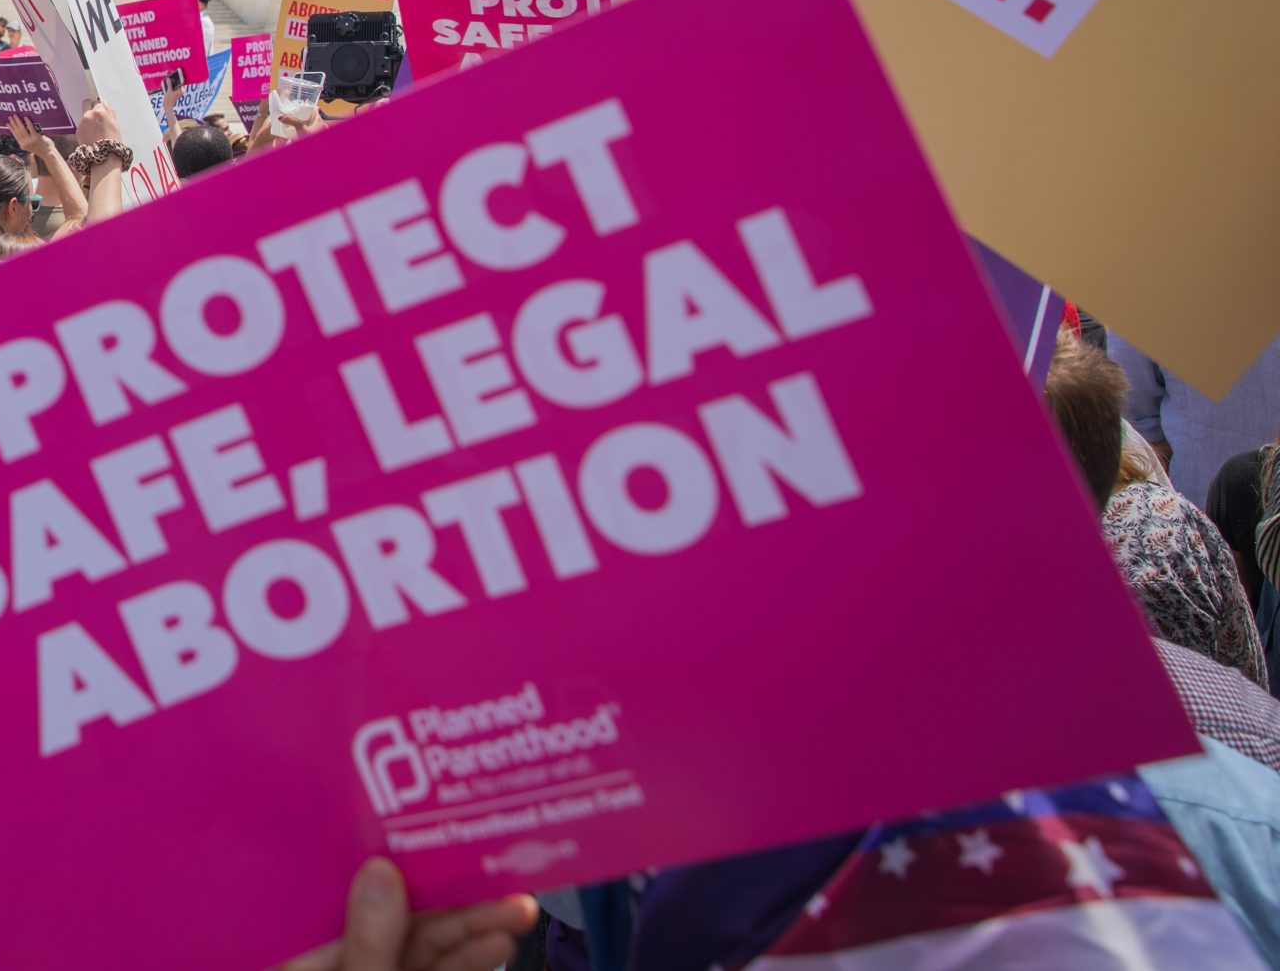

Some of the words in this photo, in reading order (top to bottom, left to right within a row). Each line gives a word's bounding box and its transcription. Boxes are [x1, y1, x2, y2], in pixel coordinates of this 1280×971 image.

[120, 10, 156, 26] STAND
[17, 97, 58, 115] Right
[21, 79, 37, 93] is
[40, 81, 51, 91] a
[337, 205, 877, 474] LEGAL
[37, 371, 866, 760] ABORTION
[408, 680, 545, 744] Planned
[422, 706, 620, 780] Parenthood
